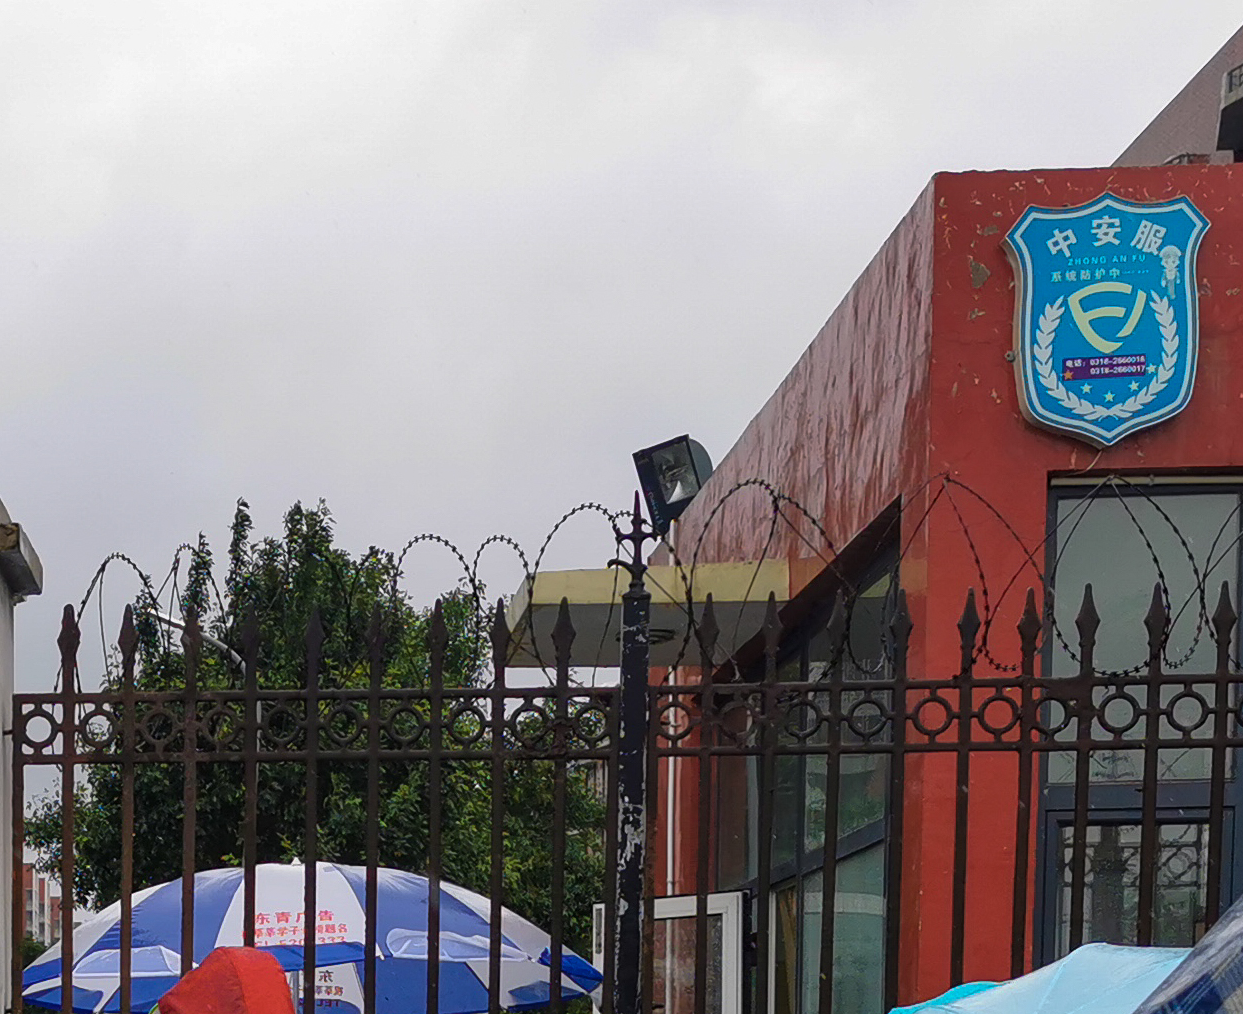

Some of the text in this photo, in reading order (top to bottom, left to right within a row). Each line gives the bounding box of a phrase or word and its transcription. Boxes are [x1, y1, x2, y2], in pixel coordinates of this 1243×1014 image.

[1046, 215, 1166, 258] 中安服
[1068, 254, 1146, 266] ZHONG AN FU
